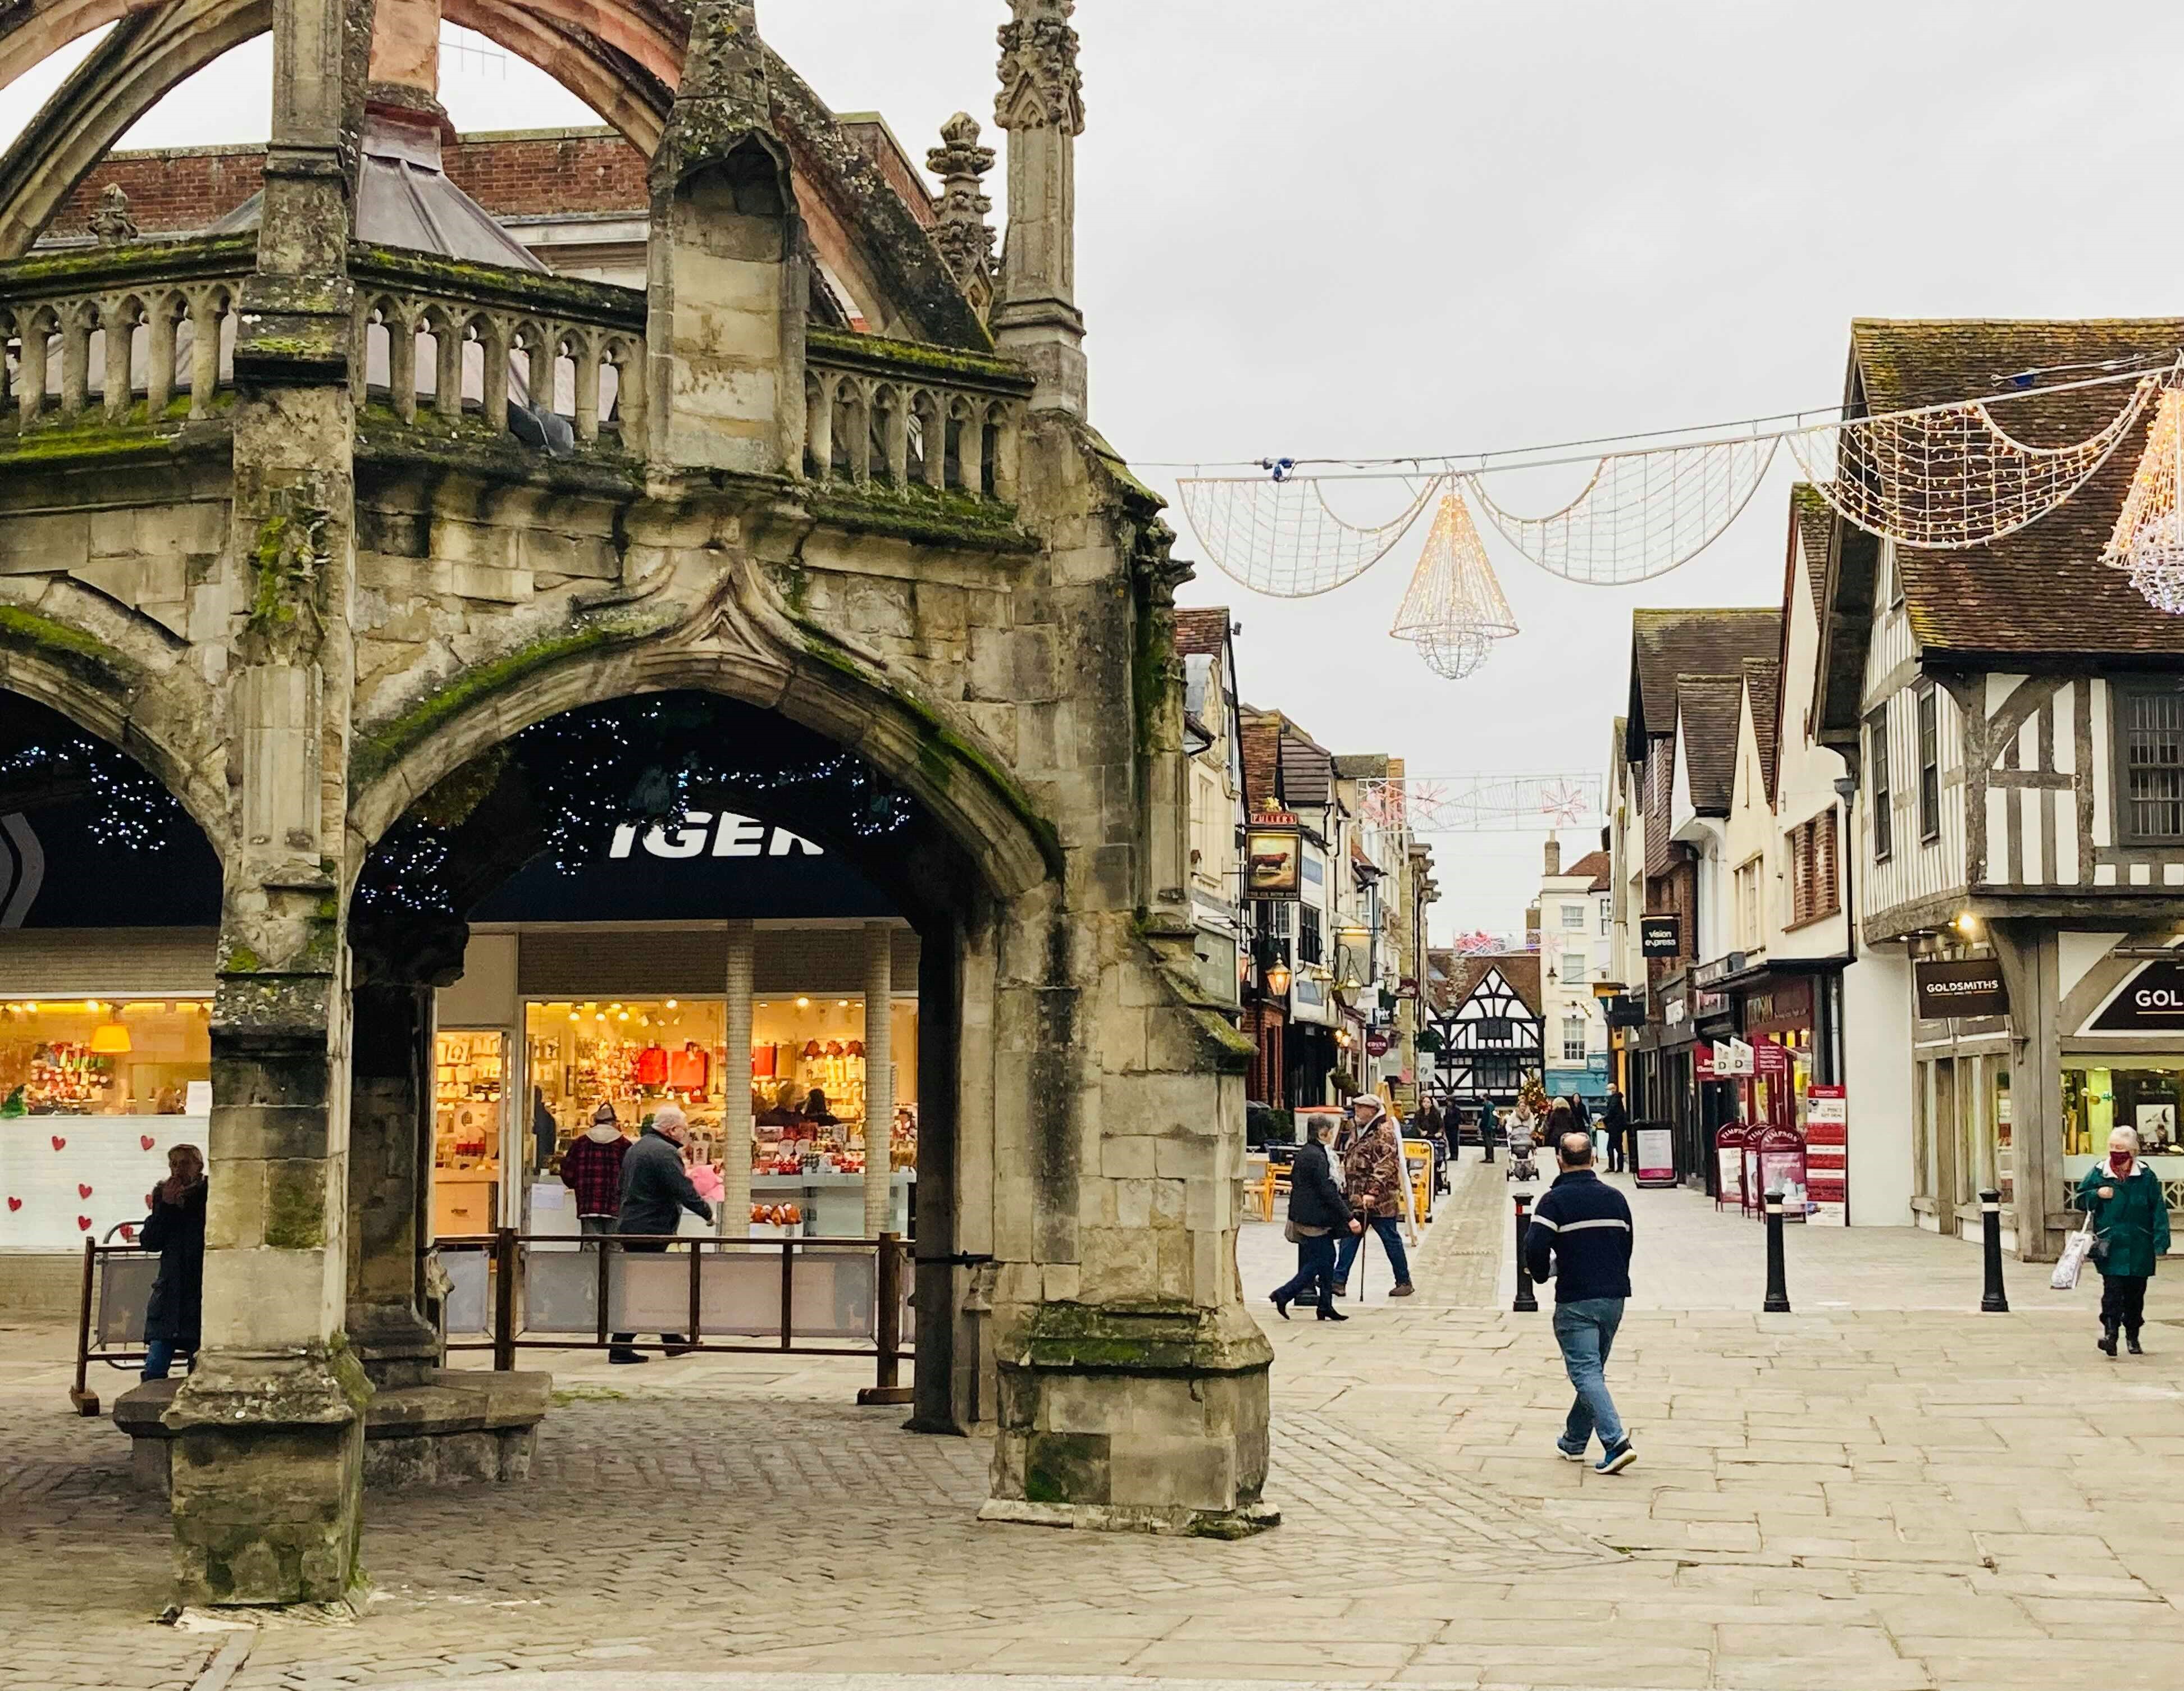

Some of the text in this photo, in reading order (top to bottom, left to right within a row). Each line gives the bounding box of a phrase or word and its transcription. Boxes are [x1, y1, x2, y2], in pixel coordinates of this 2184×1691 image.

[1648, 930, 1672, 938] vision
[1926, 980, 1999, 993] GOLDSMITHS
[1764, 1131, 1797, 1142] TIMPSON
